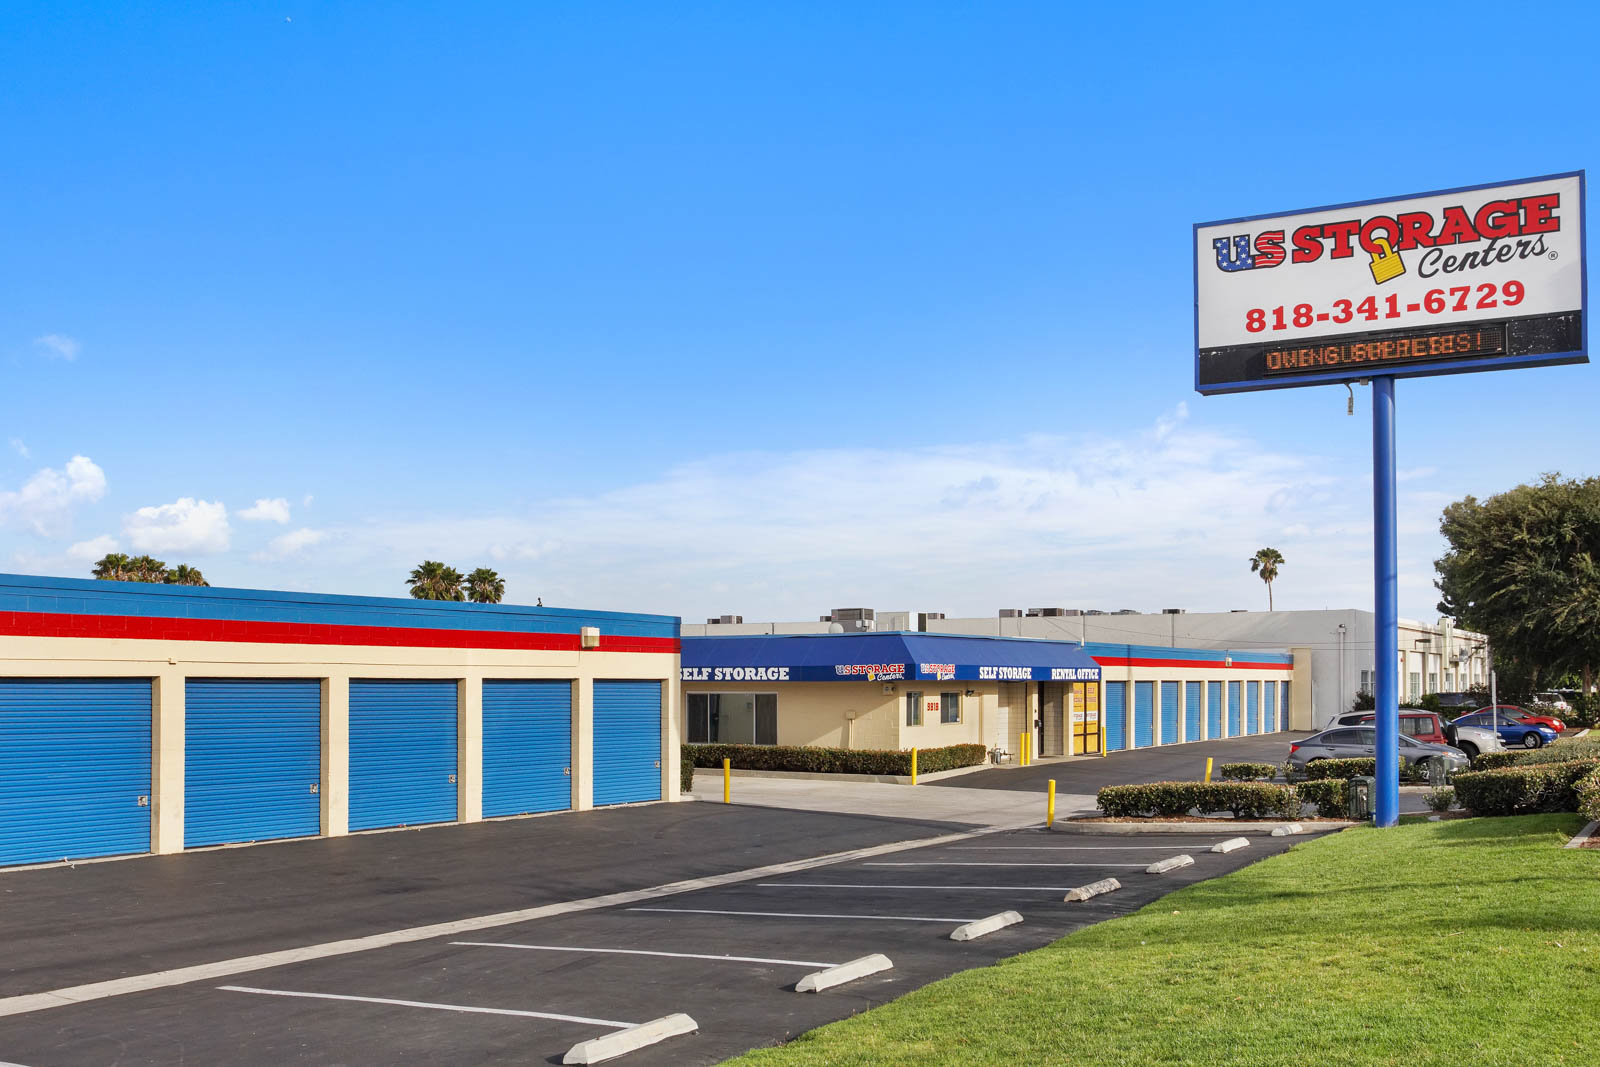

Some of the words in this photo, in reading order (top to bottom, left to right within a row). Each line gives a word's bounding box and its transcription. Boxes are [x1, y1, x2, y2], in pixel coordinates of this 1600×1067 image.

[1213, 230, 1286, 273] US
[1291, 192, 1561, 264] STORAGE
[1245, 279, 1526, 334] 818-341-6729
[714, 667, 790, 681] STORAGE
[852, 663, 905, 675] STORAGE
[979, 666, 998, 680] SELF
[998, 667, 1032, 680] STORAGE
[1051, 668, 1076, 680] RENTAL
[1076, 668, 1099, 680] OFFICE
